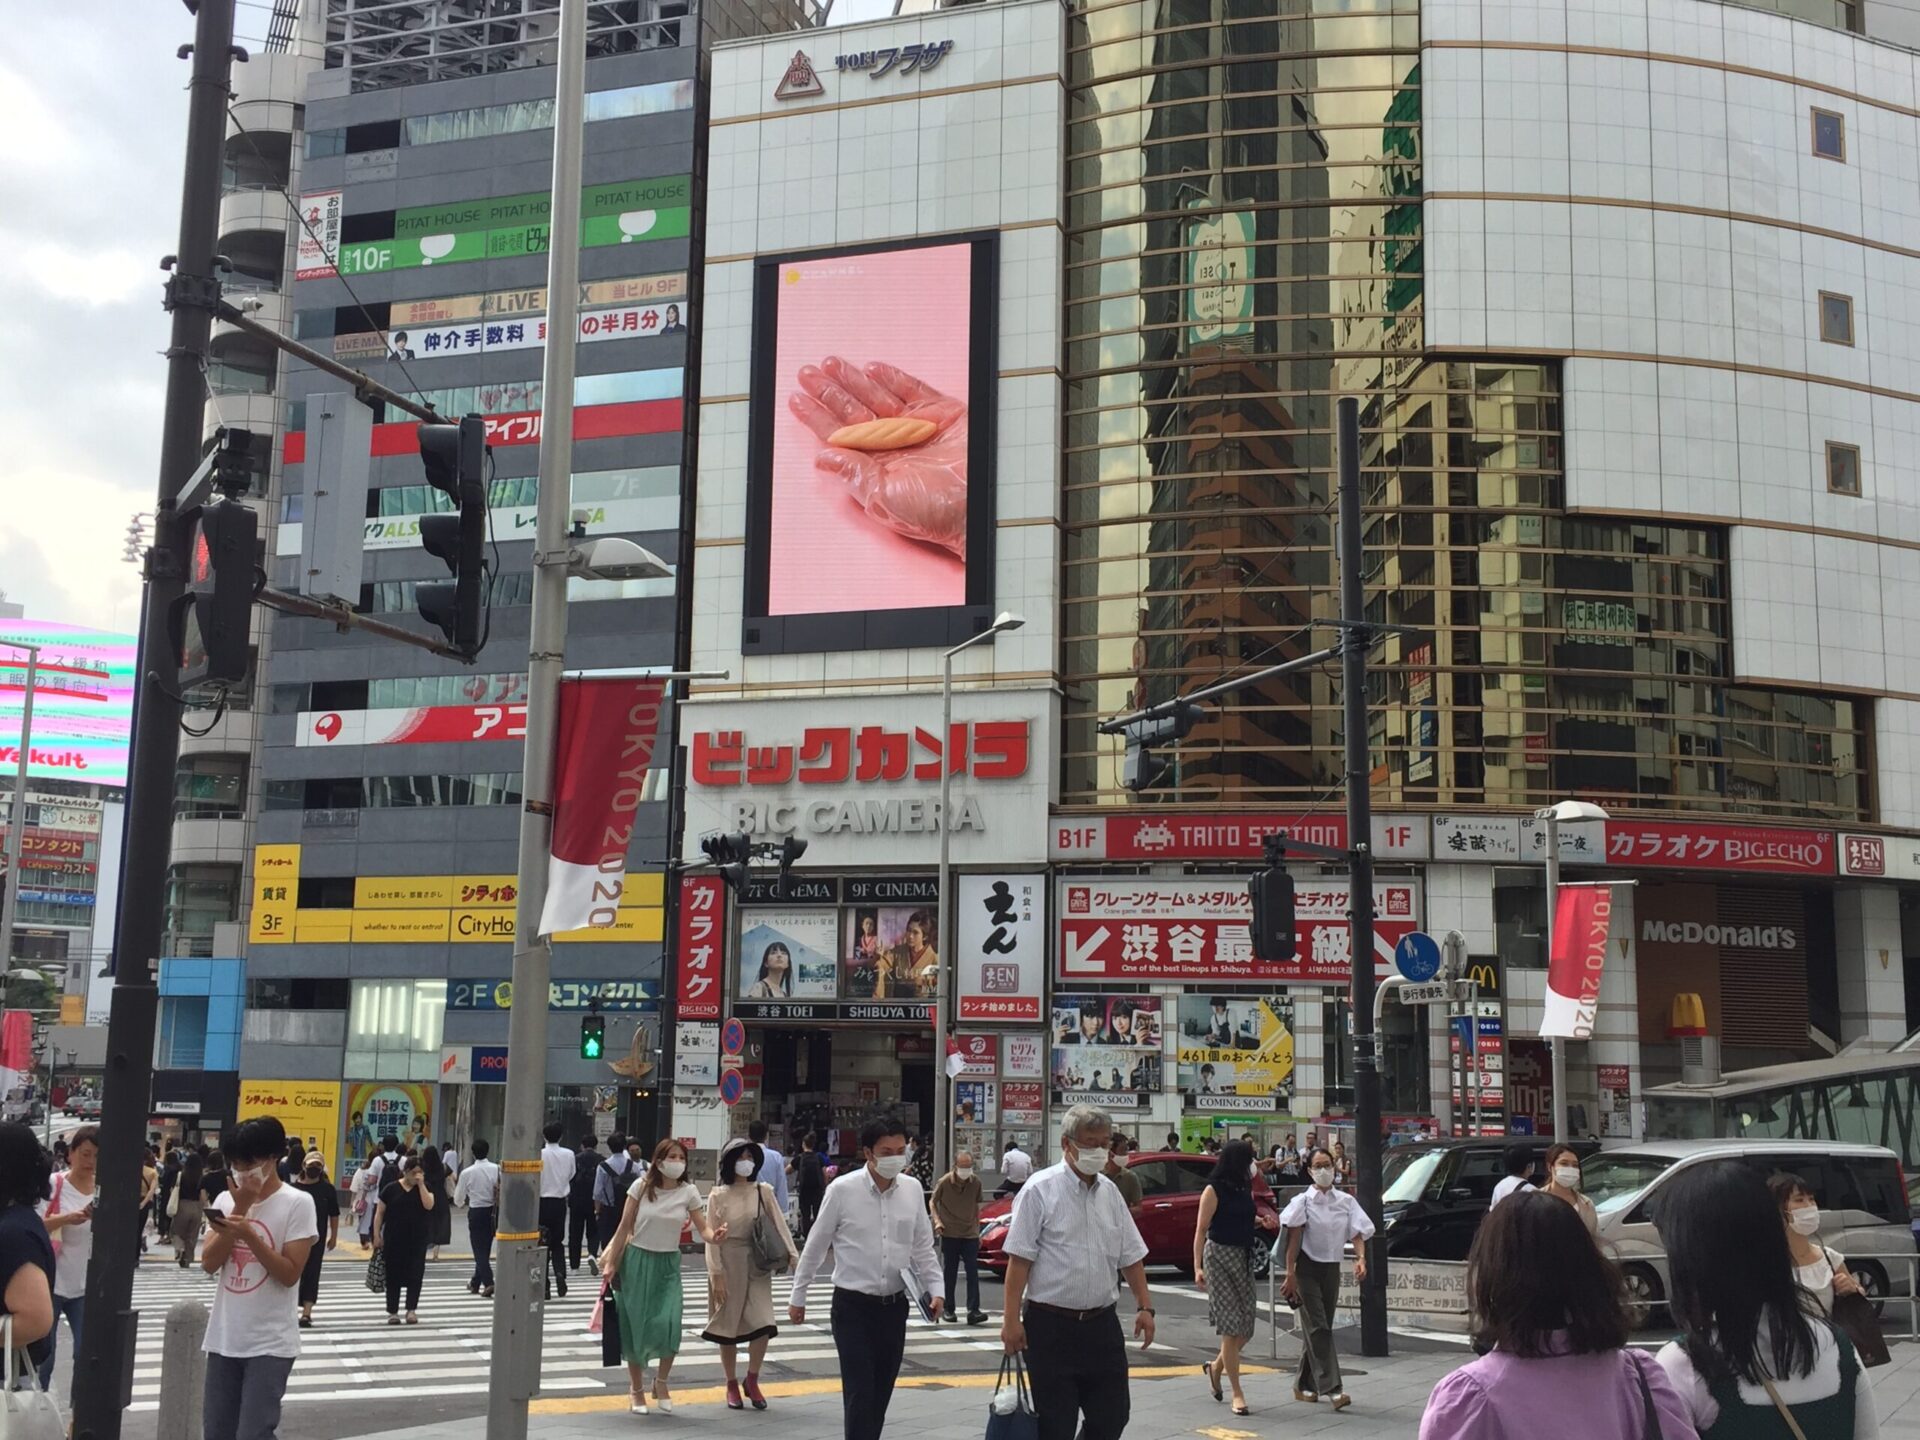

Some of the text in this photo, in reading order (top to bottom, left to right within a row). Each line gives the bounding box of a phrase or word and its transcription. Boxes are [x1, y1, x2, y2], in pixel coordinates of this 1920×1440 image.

[595, 185, 684, 208] PITAT HOUSE
[397, 209, 481, 231] PITAT HOUSE
[490, 206, 524, 221] PITAT
[325, 197, 338, 265] お部屋探しは
[352, 247, 391, 271] 10F
[613, 278, 679, 299] 当ビル 9F
[424, 324, 525, 352] 仲介手数料
[11, 650, 108, 672] トス緩和
[472, 707, 528, 740] アコ
[0, 746, 88, 769] Yakult
[693, 720, 1030, 785] ビックカメラ
[590, 685, 665, 931] TOKYO 2020
[731, 798, 985, 834] BIC CAMERA
[1436, 817, 1450, 826] 6F
[1521, 819, 1535, 828] 6F
[22, 838, 81, 854] コンタクト
[1058, 829, 1097, 849] B1F
[1180, 826, 1239, 847] TAITO
[1385, 827, 1412, 848] 1F
[1816, 832, 1831, 843] 6F
[1609, 831, 1720, 862] カラオケ
[683, 879, 696, 887] 6F
[748, 881, 832, 899] 7F CEMA
[852, 881, 939, 899] 9F CINEMA
[262, 887, 287, 901] 賃貸
[262, 914, 283, 931] 3F
[364, 923, 389, 931] whether
[458, 914, 515, 935] CityHo
[982, 880, 1017, 955] えん
[685, 885, 716, 1000] カラオケ
[1121, 924, 1352, 964] 渋谷最級
[1641, 919, 1798, 951] McDonald's
[1122, 964, 1253, 975] One of the best lineups in Shibuya.
[1573, 887, 1614, 1038] TOKYO 2020
[454, 986, 487, 1008] 2F
[546, 981, 651, 1011] 央コンタクト
[1402, 987, 1444, 1000] 歩行者優先
[757, 1005, 813, 1018] 渋谷 TOEI
[849, 1006, 904, 1018] SHIBUYA
[961, 1001, 1038, 1014] ランチ始めました。
[1181, 1048, 1294, 1067] 461個のおべんとう
[1004, 1083, 1039, 1092] カラオケ
[245, 1095, 289, 1106] シティホーム
[294, 1095, 334, 1108] CityHome
[1066, 1094, 1134, 1105] COMING SOON
[1199, 1097, 1272, 1109] COMING SOON
[368, 1113, 408, 1126] 事前審査
[230, 1275, 250, 1289] TMT
